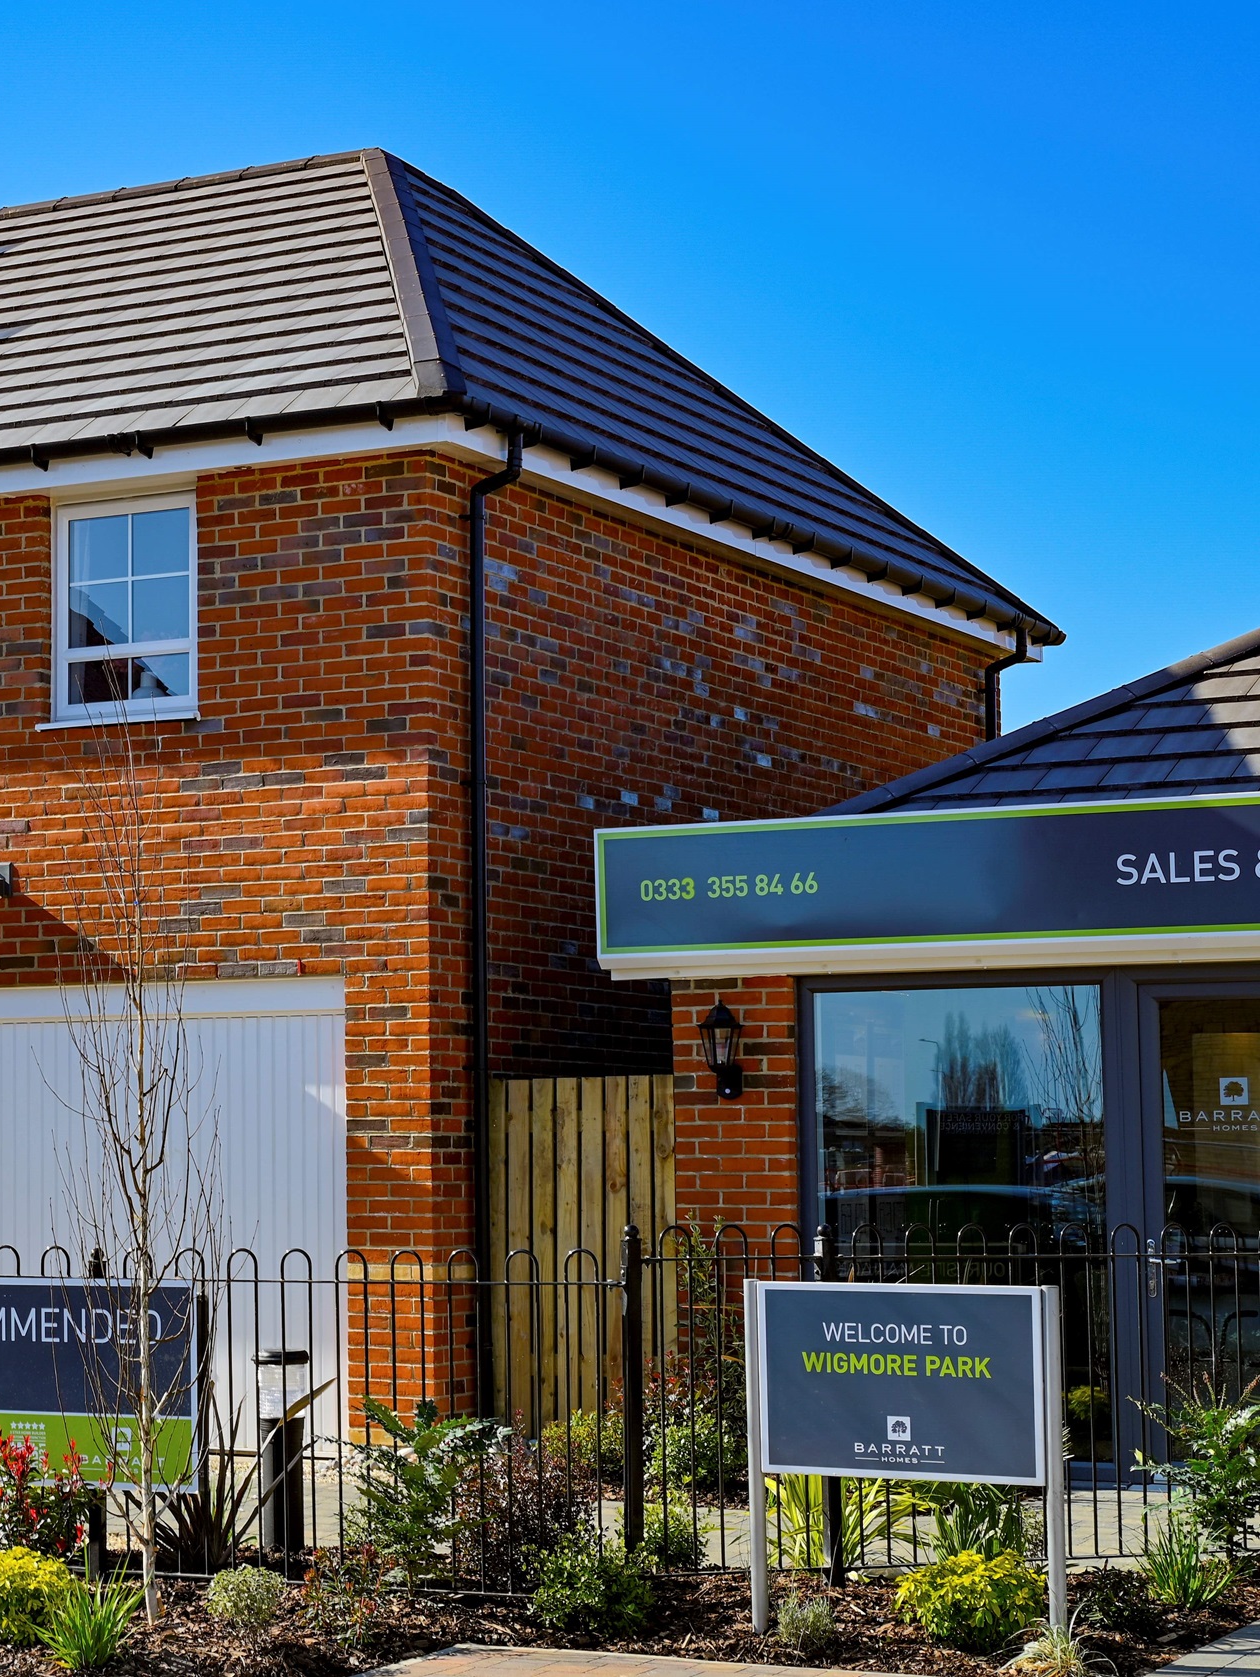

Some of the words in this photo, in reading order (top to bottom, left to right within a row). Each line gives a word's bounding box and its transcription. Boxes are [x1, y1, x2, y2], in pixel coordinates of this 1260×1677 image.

[1116, 849, 1241, 885] SALES
[640, 877, 695, 901] 0333
[707, 875, 748, 898] 355
[755, 873, 783, 896] 84
[790, 871, 819, 894] 66
[1212, 1124, 1258, 1132] HOMES
[822, 1321, 933, 1345] WELCOME
[939, 1325, 967, 1346] TO
[801, 1351, 918, 1376] WIGMORE
[925, 1356, 992, 1379] PARK
[854, 1442, 945, 1457] BARRATT
[80, 1454, 165, 1467] BARRAT
[881, 1456, 918, 1464] HOMES
